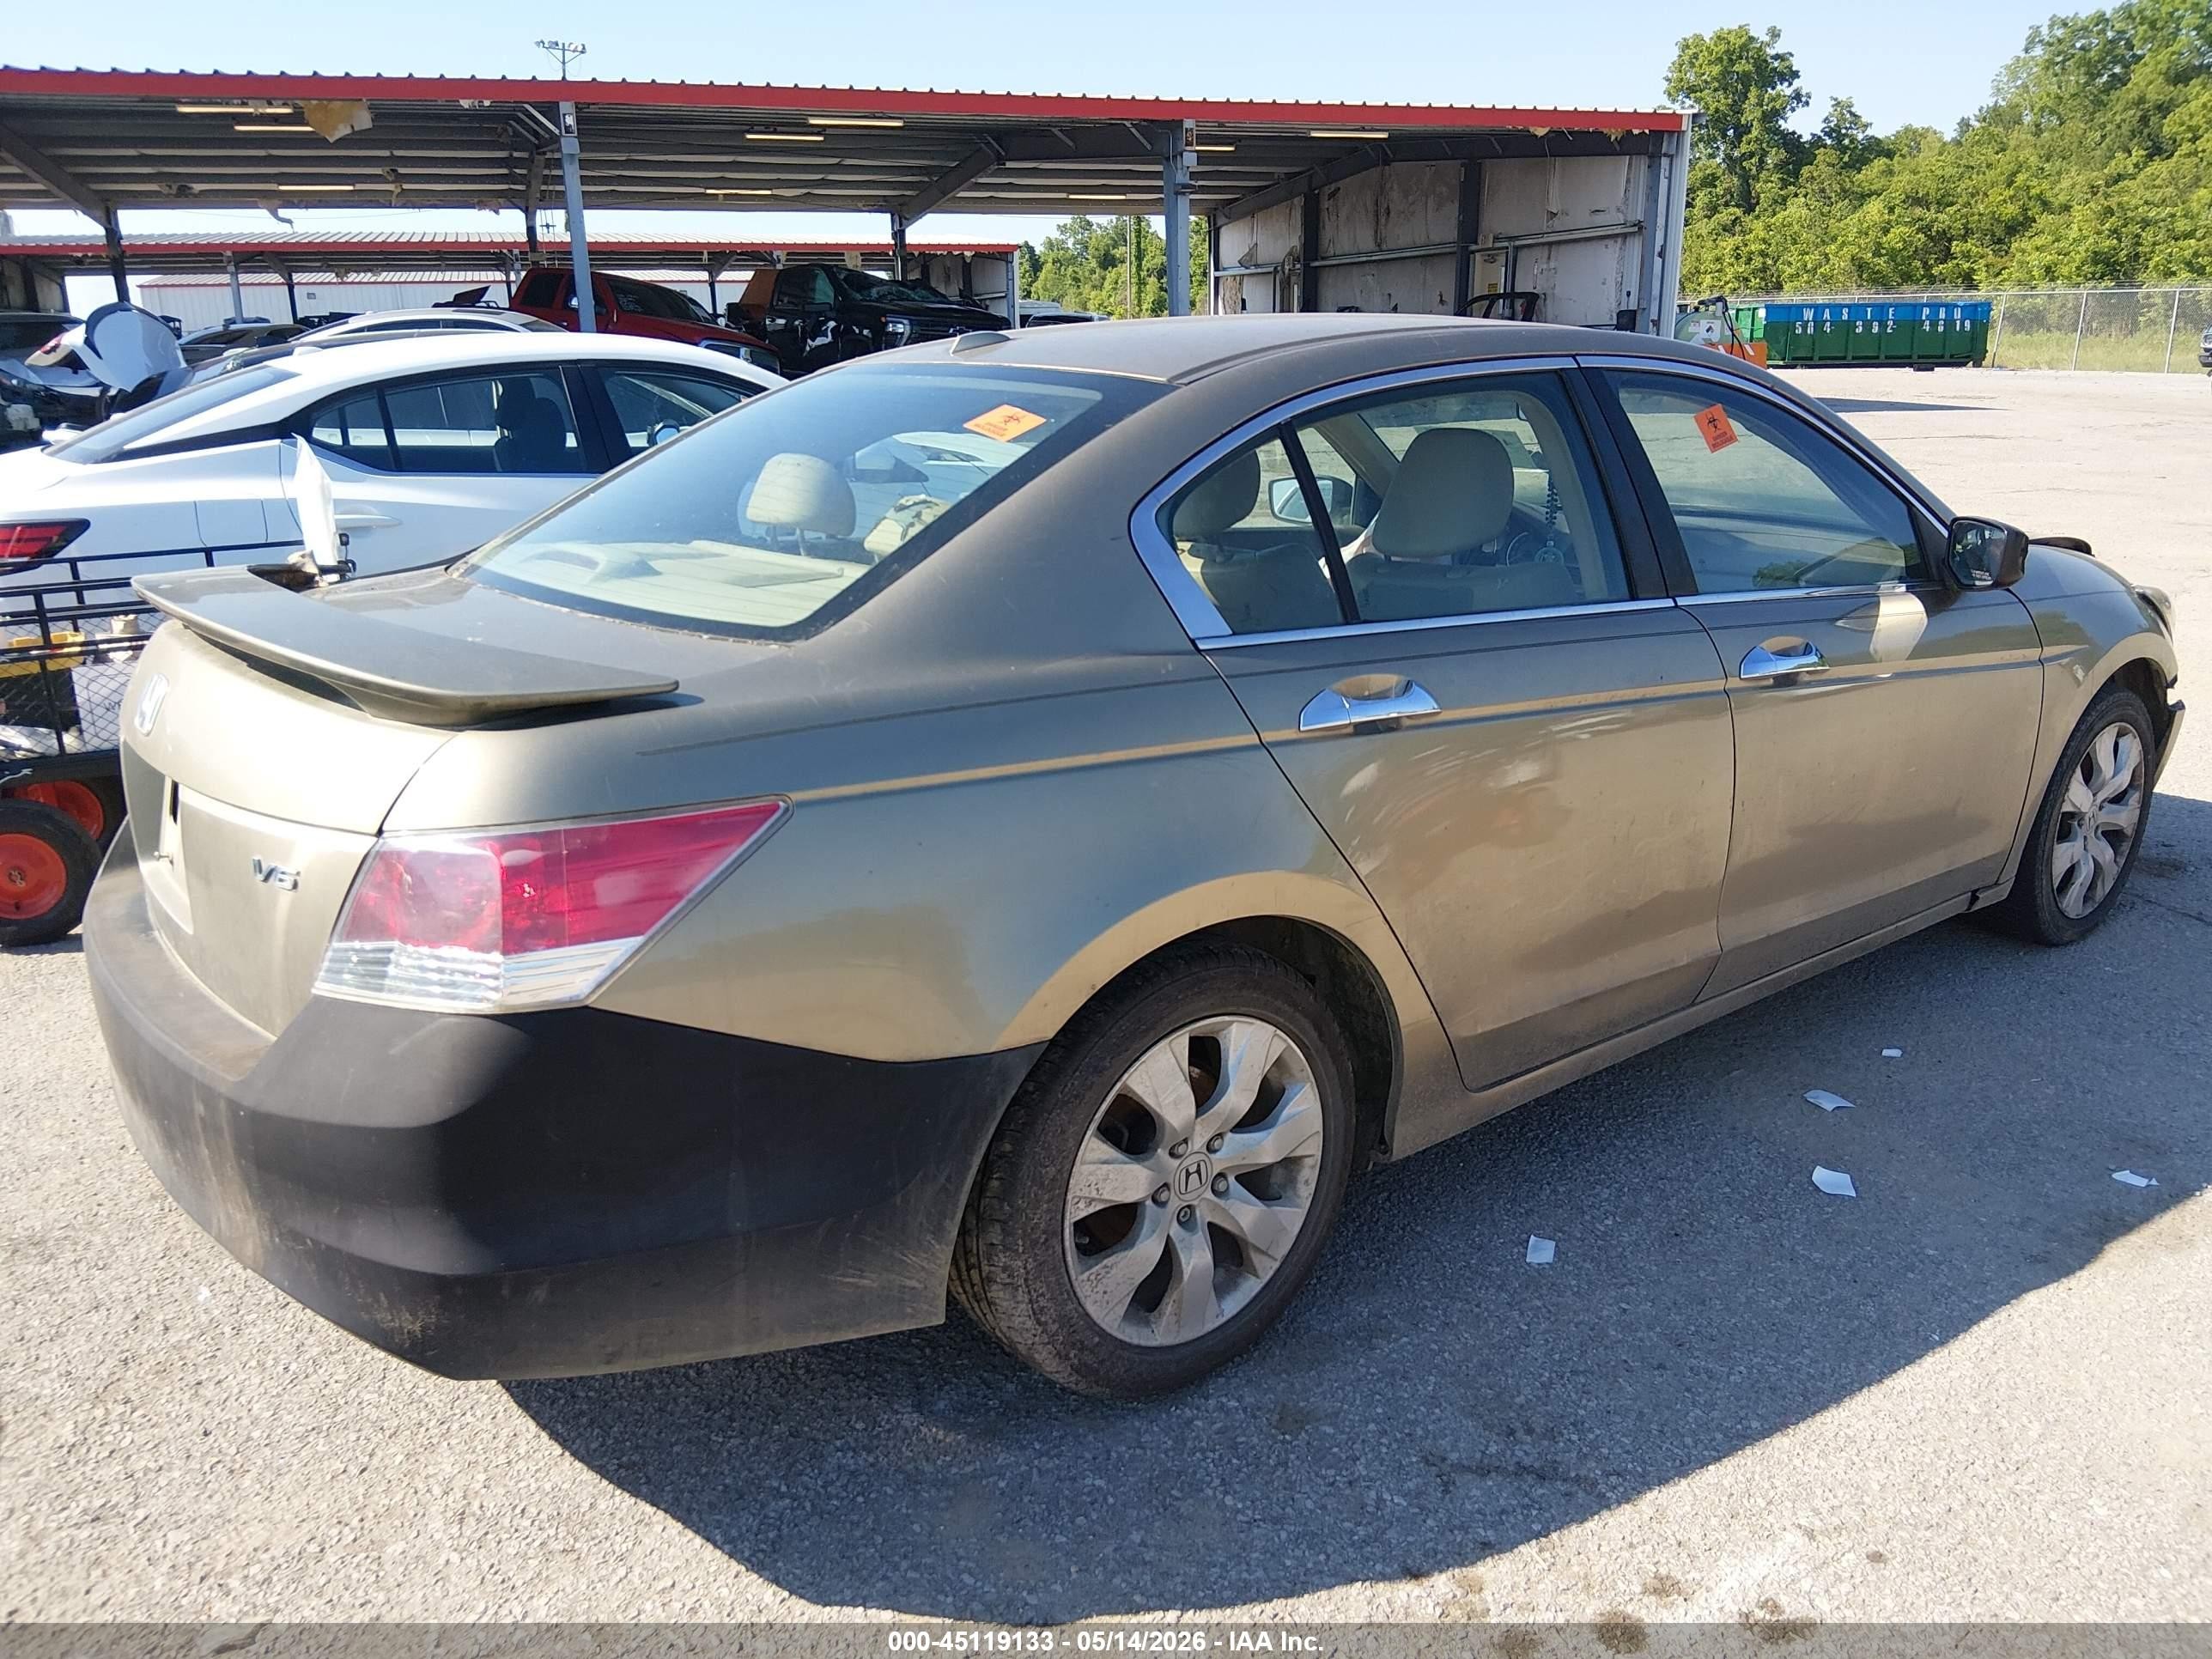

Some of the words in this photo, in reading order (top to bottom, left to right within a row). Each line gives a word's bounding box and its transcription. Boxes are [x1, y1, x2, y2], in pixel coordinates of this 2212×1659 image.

[1802, 307, 1895, 320] WASTE
[1922, 306, 1961, 320] PRO
[252, 856, 301, 892] V6
